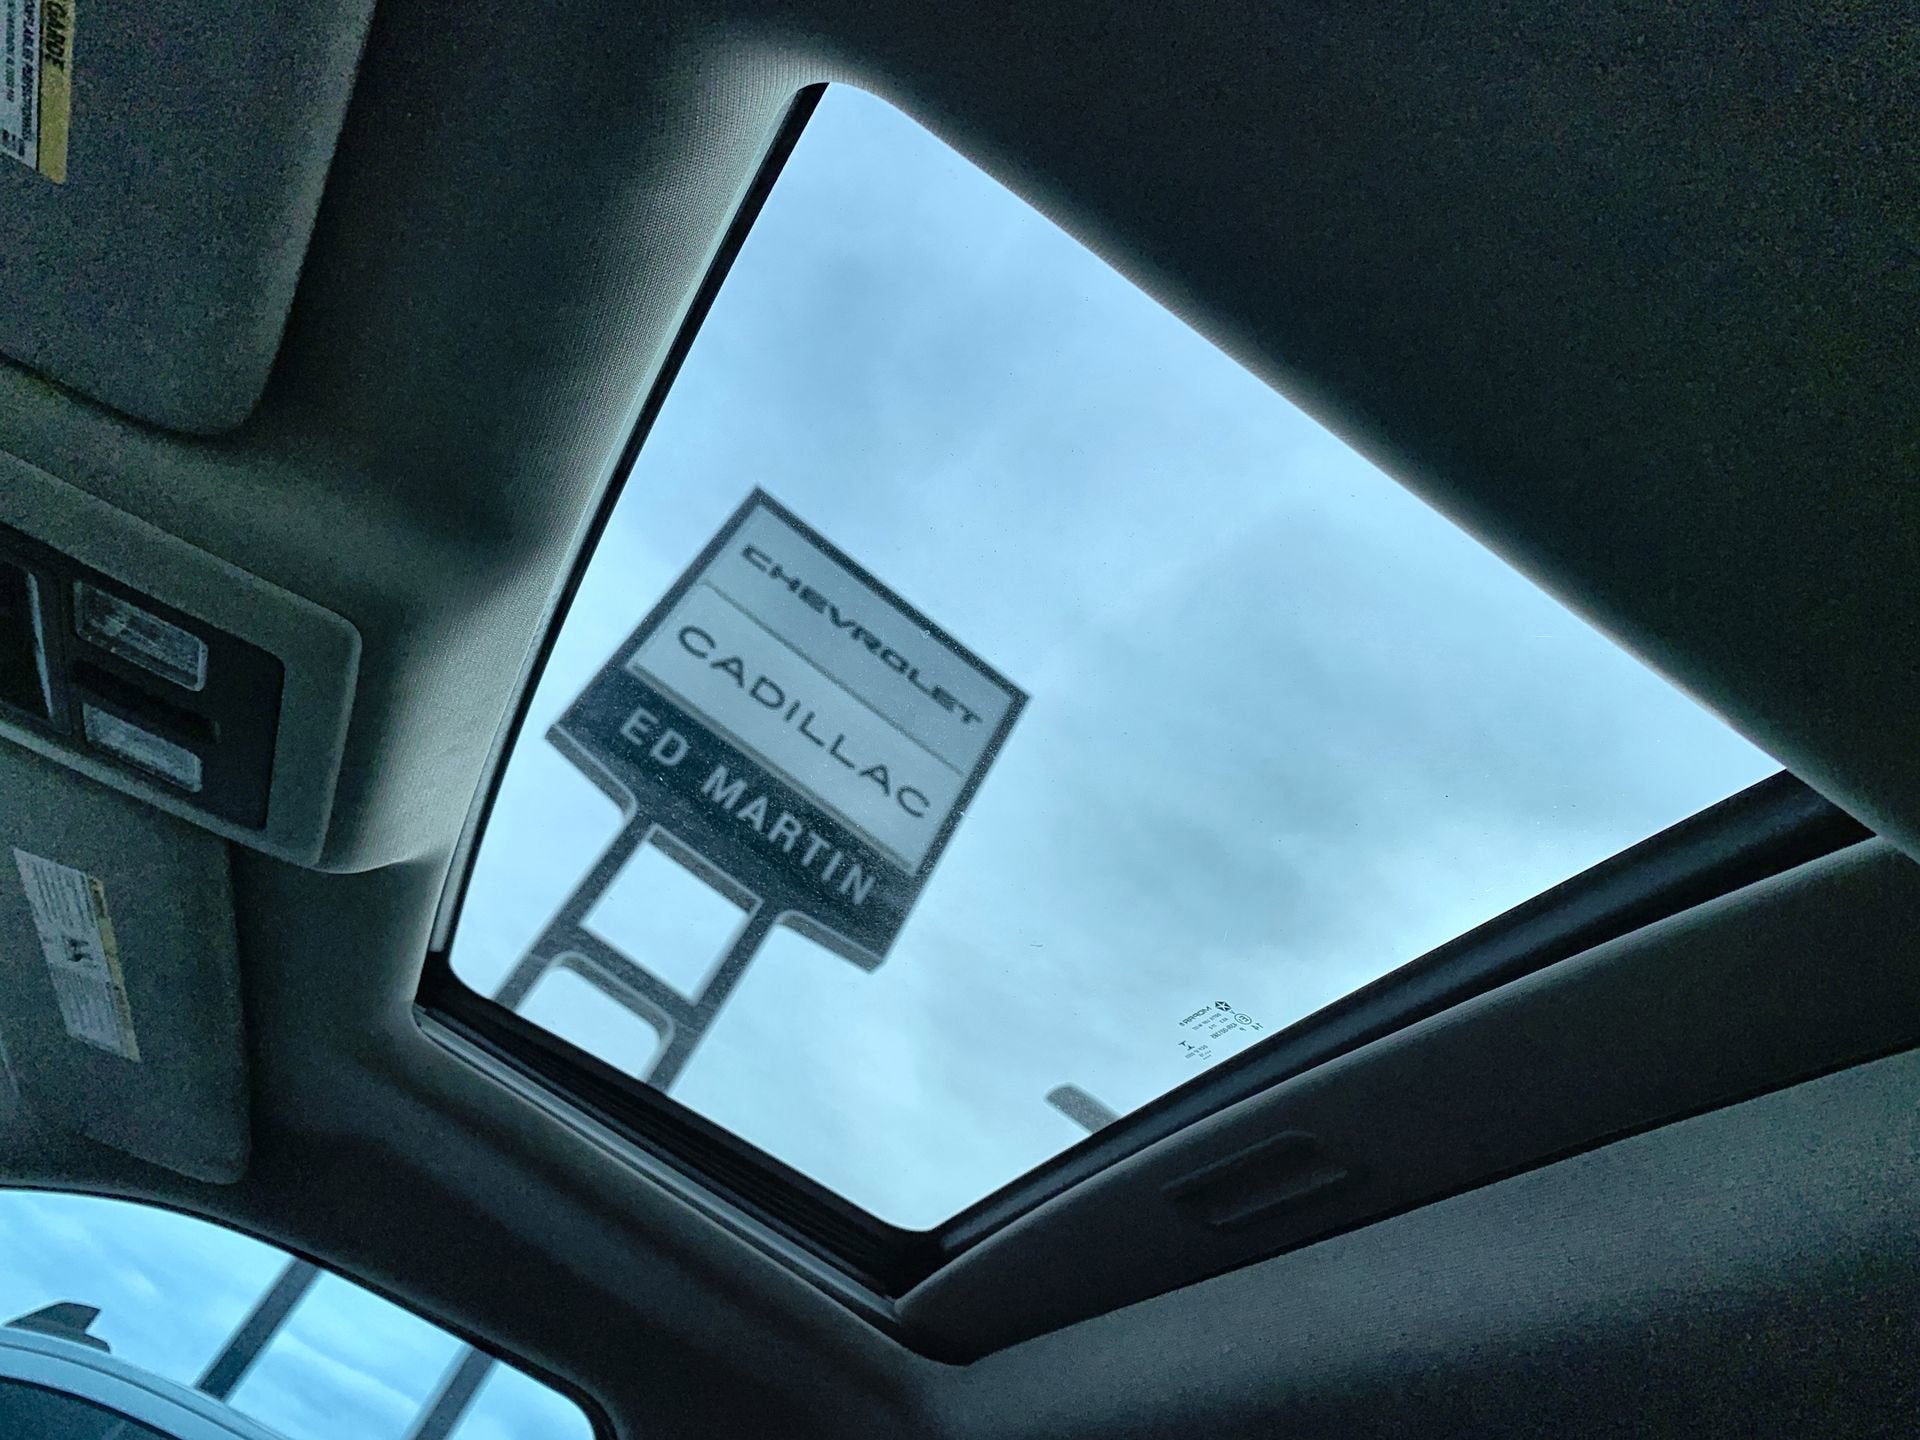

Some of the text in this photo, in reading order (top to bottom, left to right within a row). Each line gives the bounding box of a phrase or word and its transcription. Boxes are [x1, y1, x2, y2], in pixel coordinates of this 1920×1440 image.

[677, 624, 931, 819] CADILLAC
[741, 544, 983, 726] CHEVROLET
[619, 706, 878, 906] ED MARTIN
